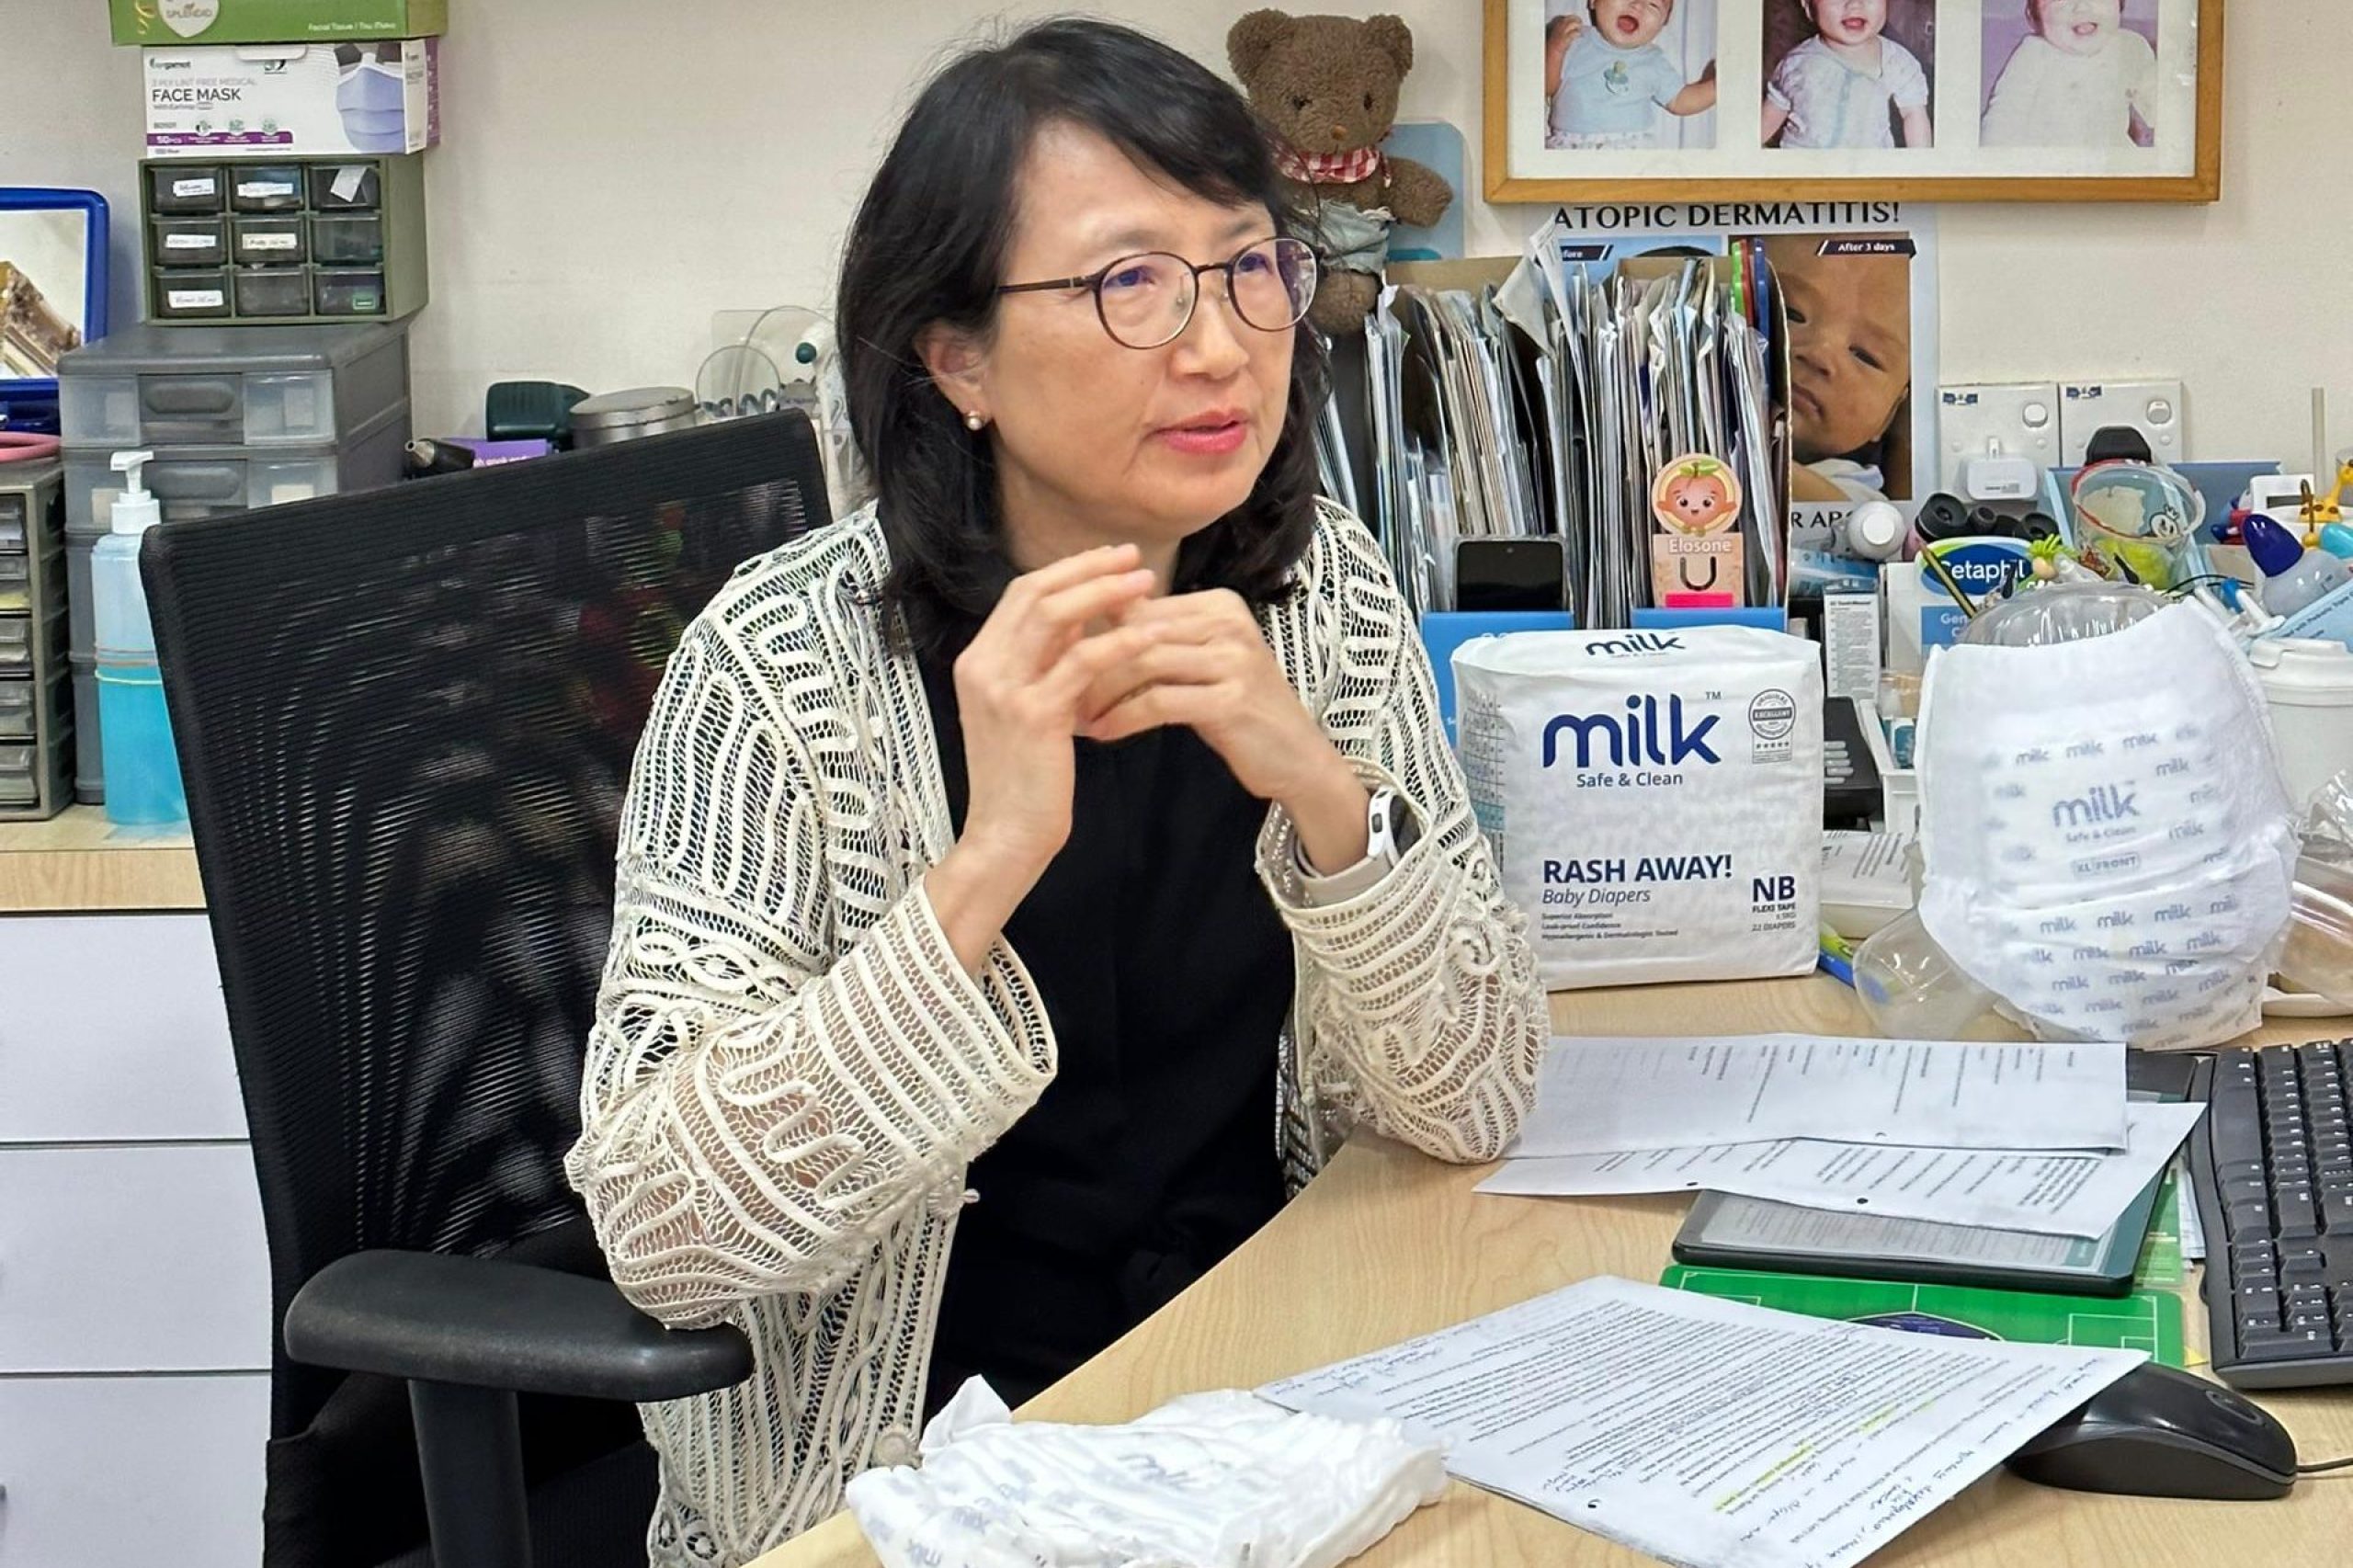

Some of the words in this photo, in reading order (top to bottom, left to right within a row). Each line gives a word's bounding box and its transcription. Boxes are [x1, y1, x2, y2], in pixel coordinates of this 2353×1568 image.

[153, 88, 193, 102] FACE
[197, 87, 242, 101] MASK
[1554, 205, 1677, 229] ATOPIC
[1688, 201, 1900, 226] DERMATITIS!
[1838, 243, 1864, 253] After
[1866, 243, 1872, 252] 3
[1874, 243, 1896, 254] days
[1668, 539, 1732, 553] Elosone
[1586, 632, 1686, 655] milk
[1542, 694, 1721, 768] milk
[2016, 748, 2051, 765] milk
[2066, 740, 2105, 758] milk
[2155, 757, 2190, 777] milk
[1576, 773, 1614, 789] Safe
[1619, 774, 1631, 788] &
[1636, 772, 1684, 788] Clean
[2052, 785, 2140, 827] milk
[1544, 859, 1626, 885] RASH
[1635, 854, 1733, 882] AWAY!
[2096, 856, 2138, 870] FRONT
[1543, 889, 1585, 908] Baby
[1588, 887, 1652, 906] Diapers
[1753, 875, 1797, 903] NB
[2040, 916, 2077, 935] milk
[2097, 911, 2134, 929] milk
[2154, 903, 2192, 923] milk
[2128, 939, 2169, 959] milk
[2186, 930, 2222, 951] milk
[2052, 974, 2091, 992] milk
[2109, 968, 2148, 986] milk
